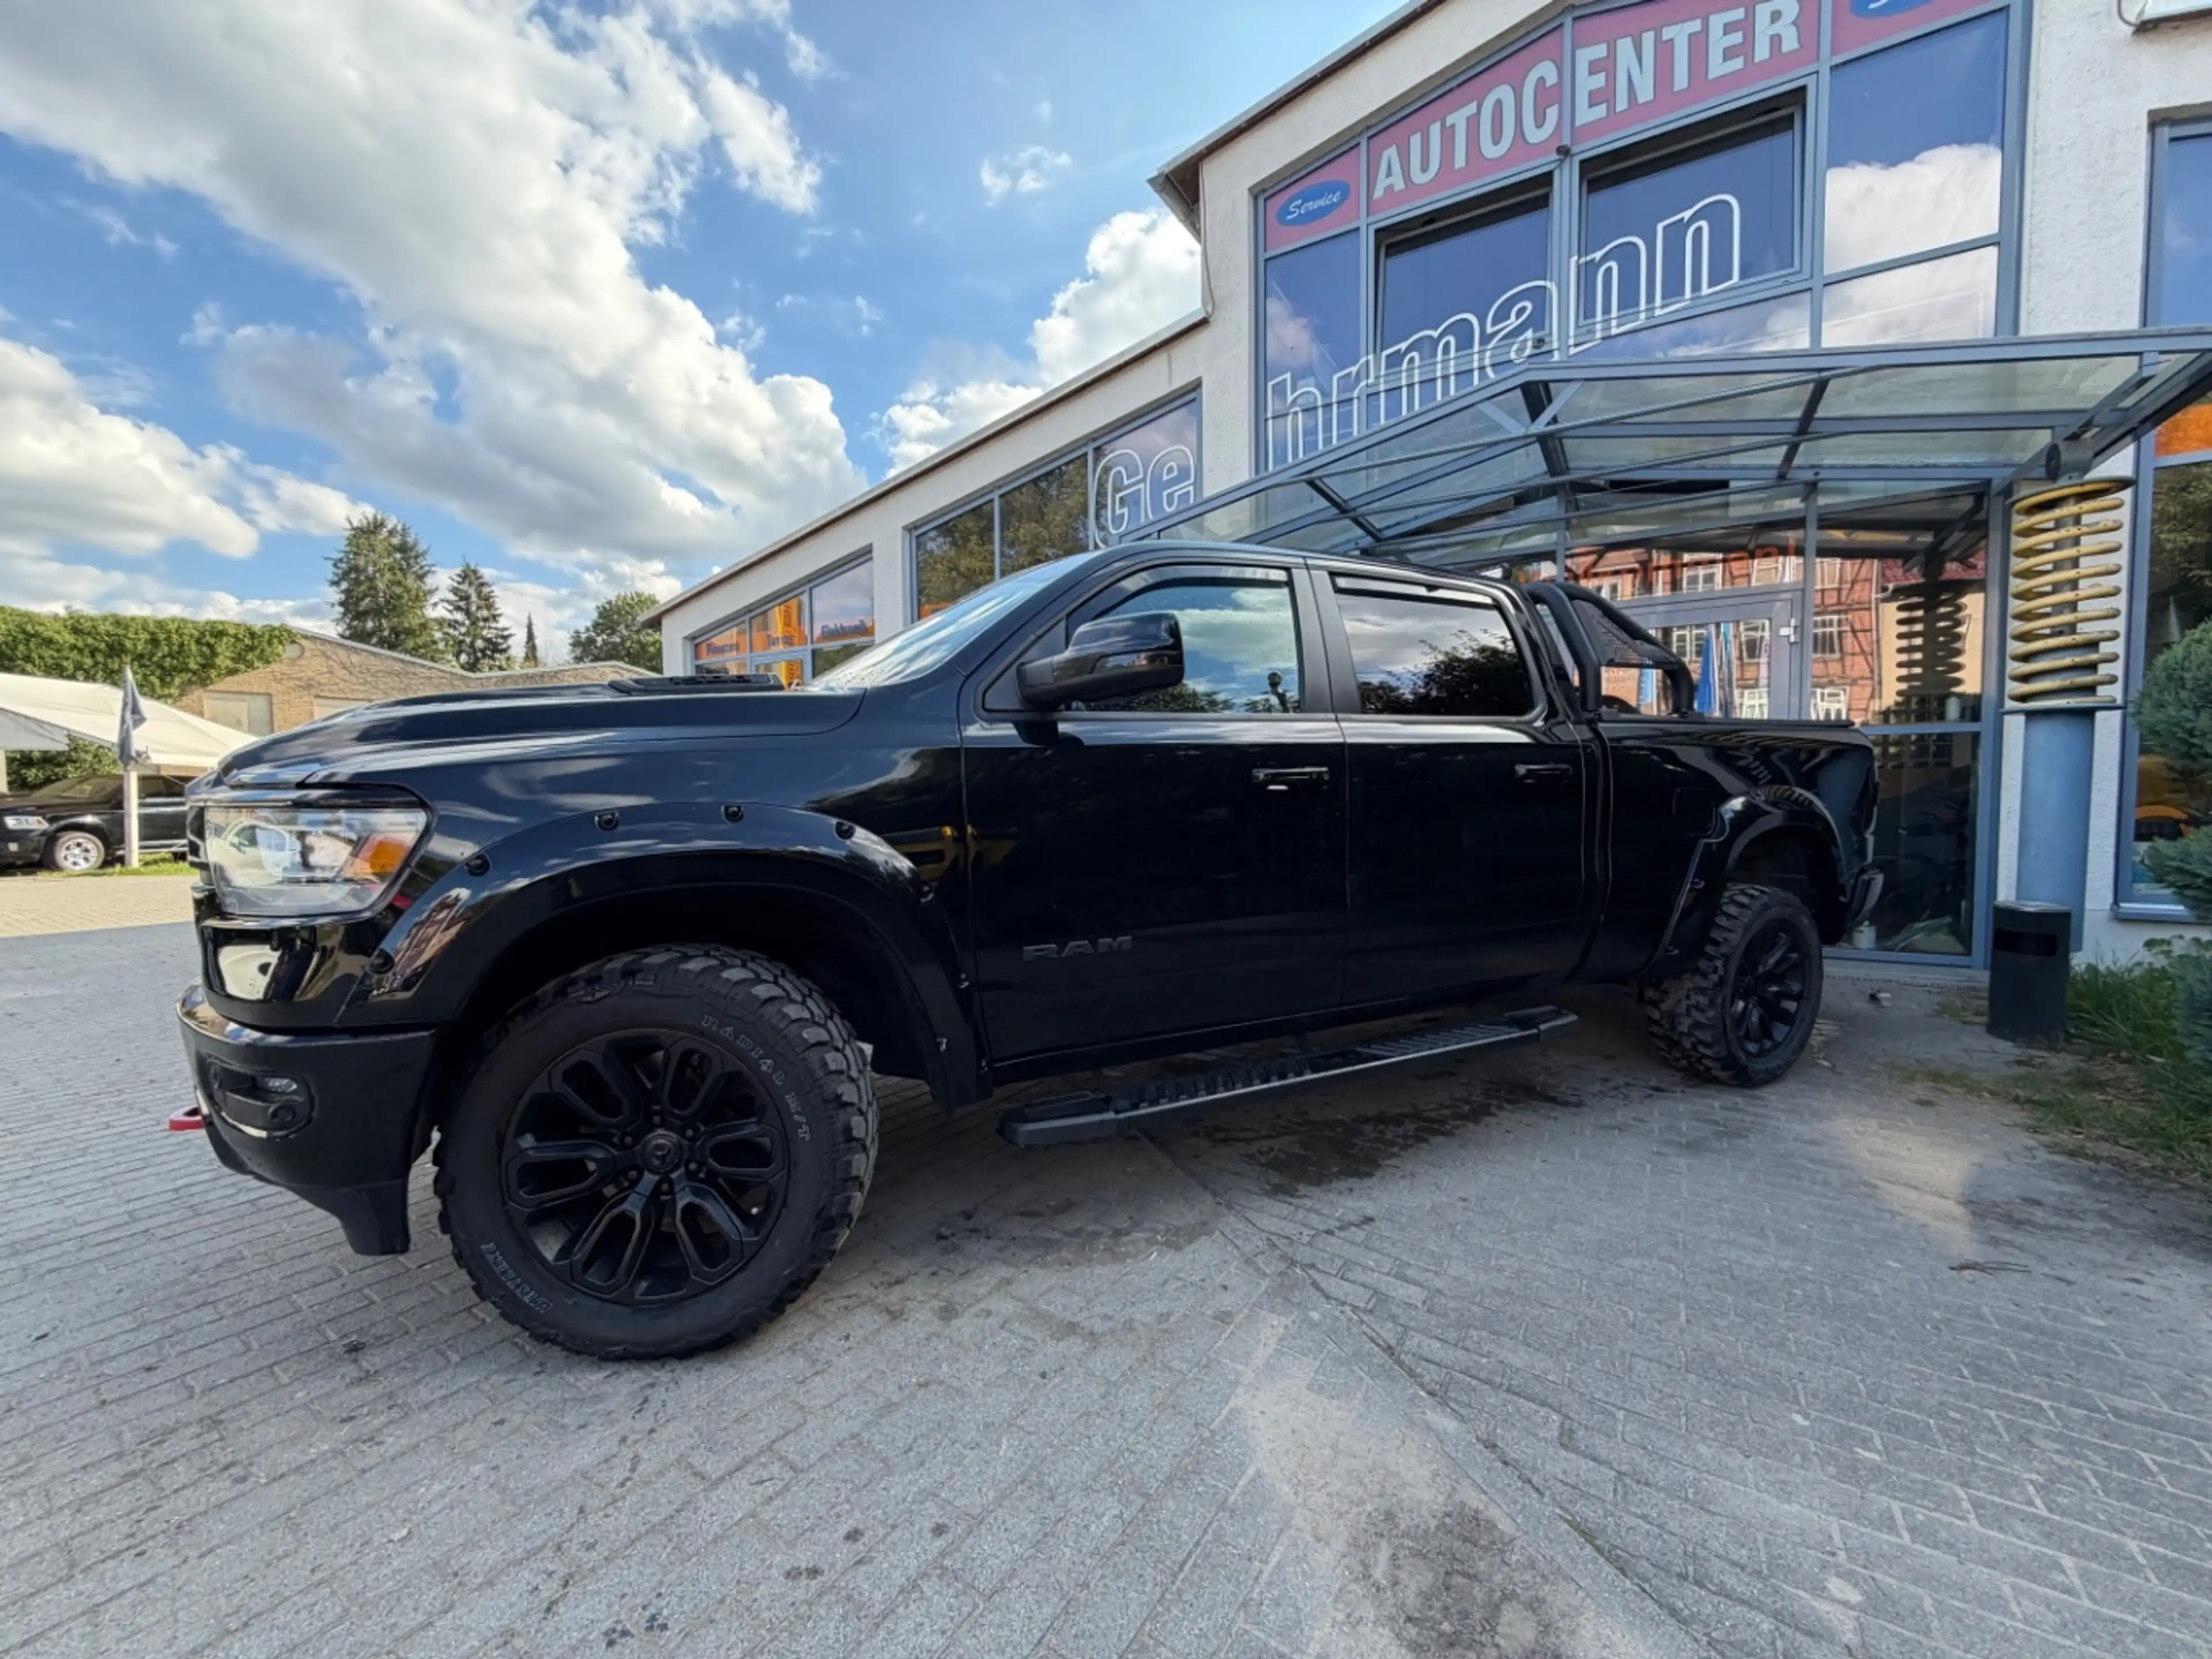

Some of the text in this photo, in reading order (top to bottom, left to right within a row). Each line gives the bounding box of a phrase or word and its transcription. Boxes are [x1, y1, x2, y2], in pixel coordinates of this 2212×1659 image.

[1372, 0, 1801, 200] AUTOCENTER
[1285, 189, 1342, 221] Service
[1022, 935, 1133, 962] RAM
[701, 1014, 785, 1085] RADIAL
